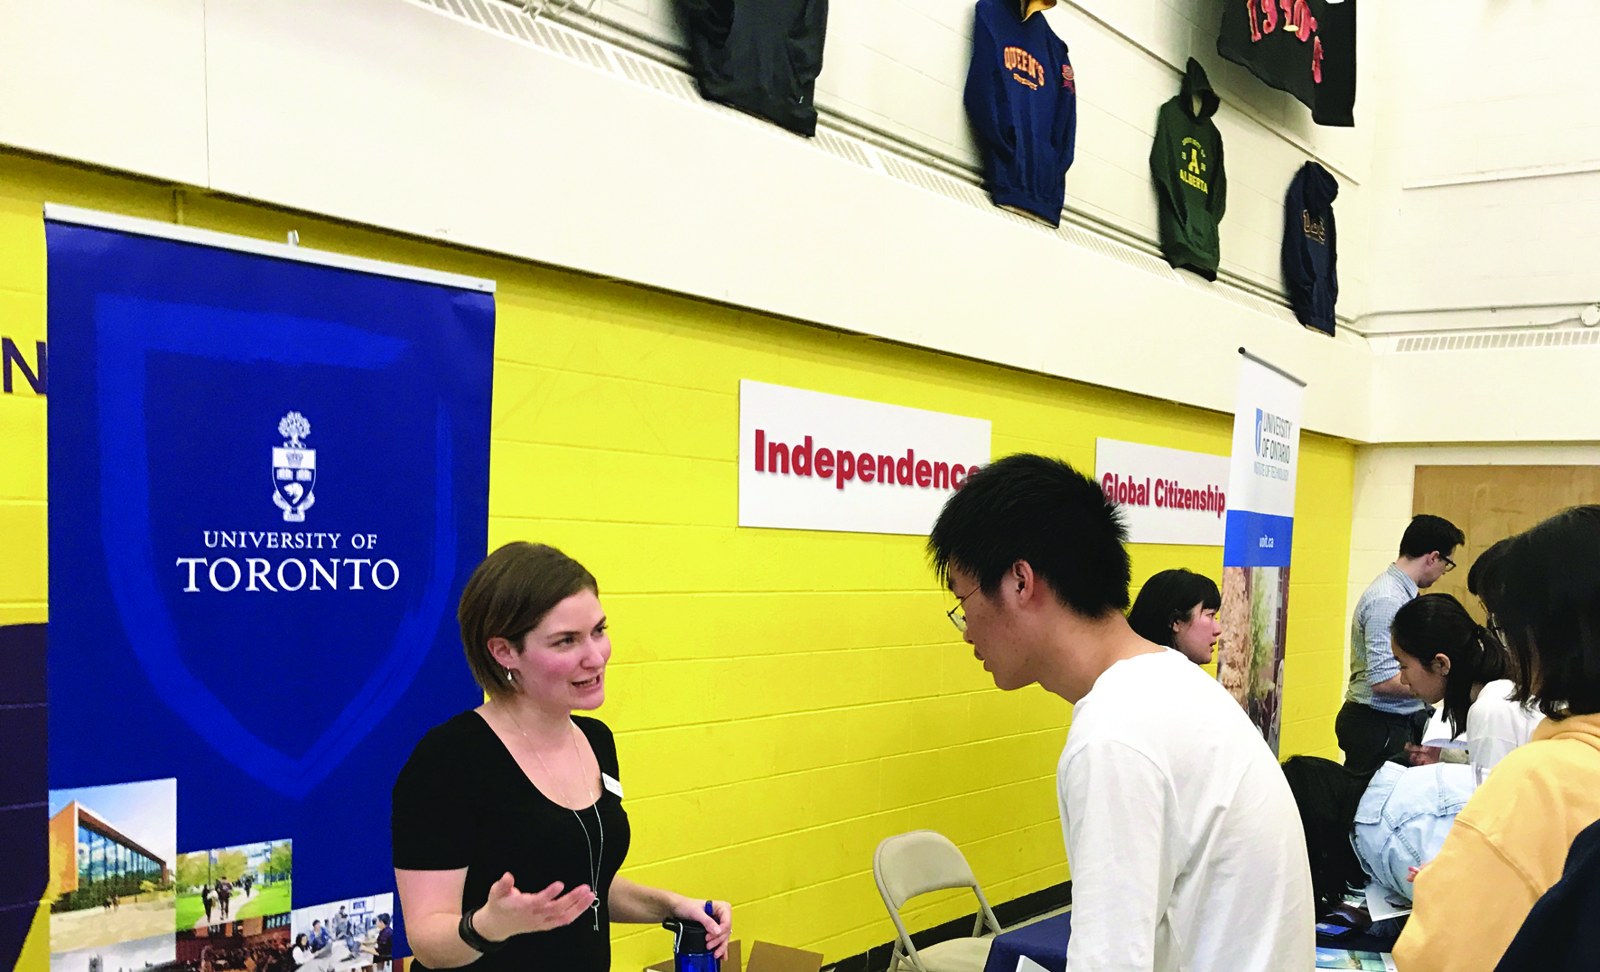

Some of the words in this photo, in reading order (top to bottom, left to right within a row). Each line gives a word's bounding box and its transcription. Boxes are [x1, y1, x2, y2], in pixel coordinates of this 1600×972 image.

[1188, 148, 1200, 175] A
[1180, 169, 1208, 195] ALBERTA
[1102, 472, 1150, 506] Global
[1154, 478, 1226, 519] Citizenship
[203, 530, 341, 549] UNIVERSITY
[351, 533, 378, 550] OF
[176, 557, 400, 592] TORONTO
